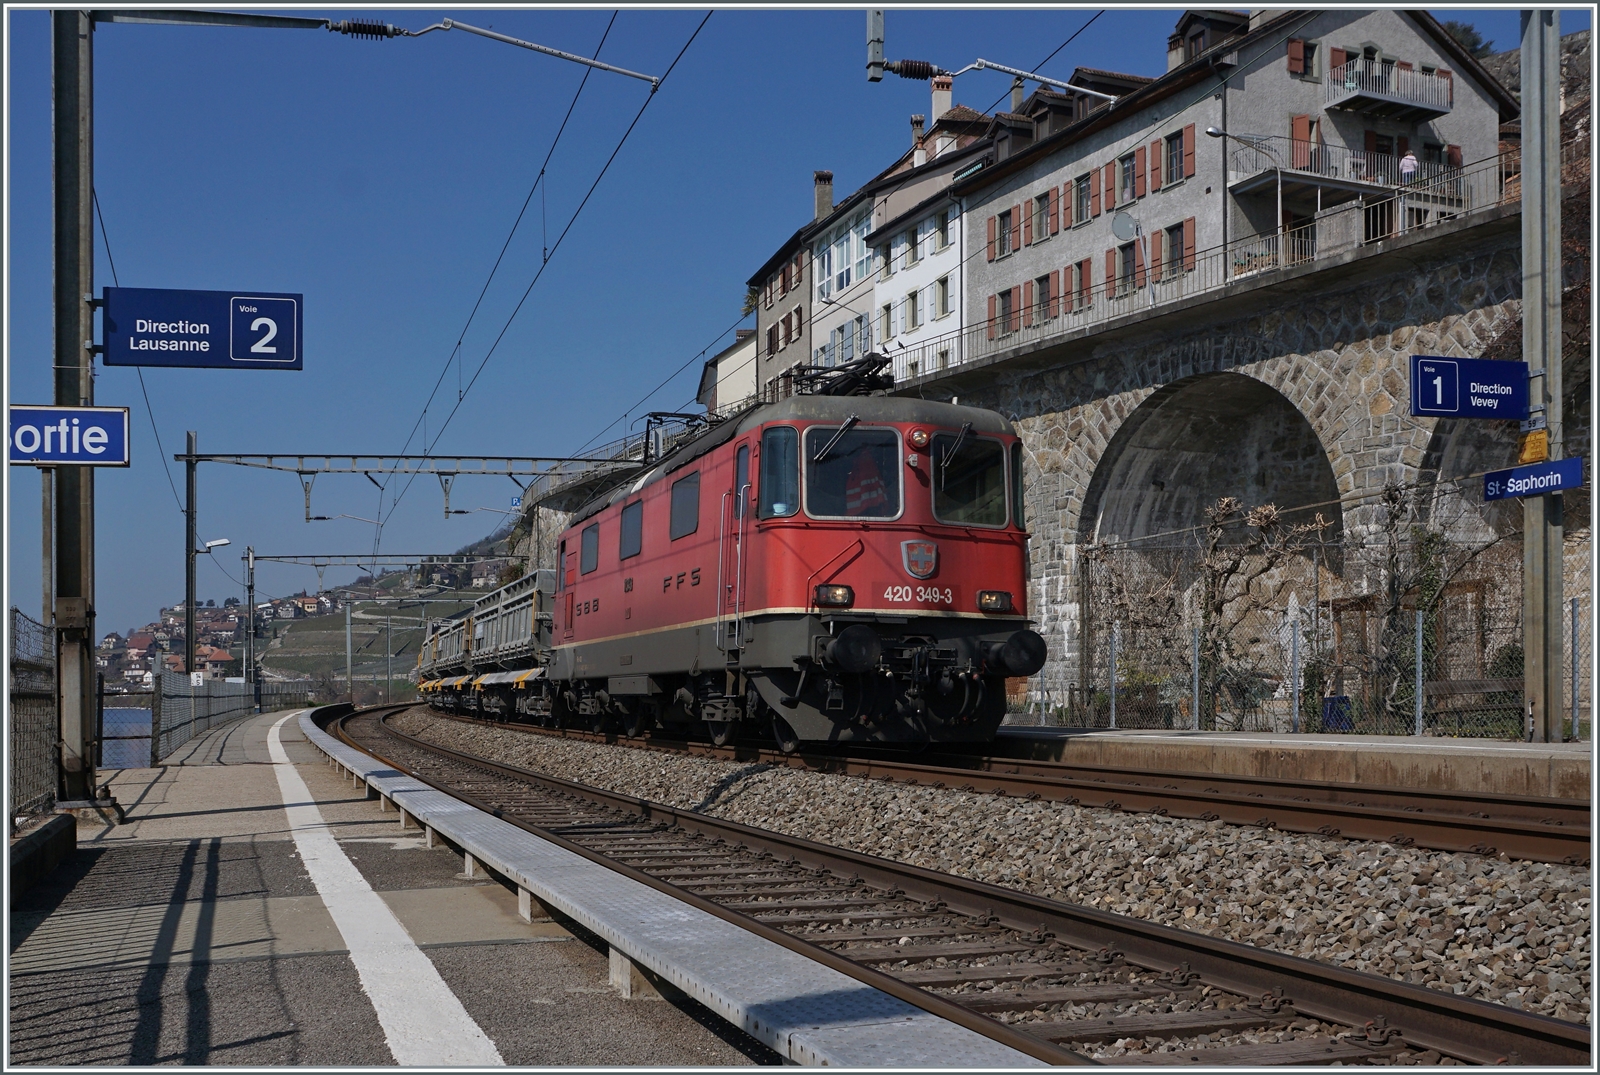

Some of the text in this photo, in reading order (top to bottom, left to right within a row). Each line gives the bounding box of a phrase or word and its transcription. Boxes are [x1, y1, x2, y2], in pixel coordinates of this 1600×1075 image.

[239, 305, 257, 313] Voie
[136, 319, 210, 335] Direction
[250, 317, 278, 354] 2
[129, 336, 210, 352] Lausanne
[1432, 376, 1442, 405] 1
[1470, 382, 1512, 395] Direction
[1470, 396, 1499, 409] Vevey
[10, 418, 109, 455] ortie
[1487, 471, 1562, 496] St-Saphorin
[663, 567, 701, 594] FFS
[883, 585, 953, 604] 420 349-3
[576, 598, 599, 617] SBB
